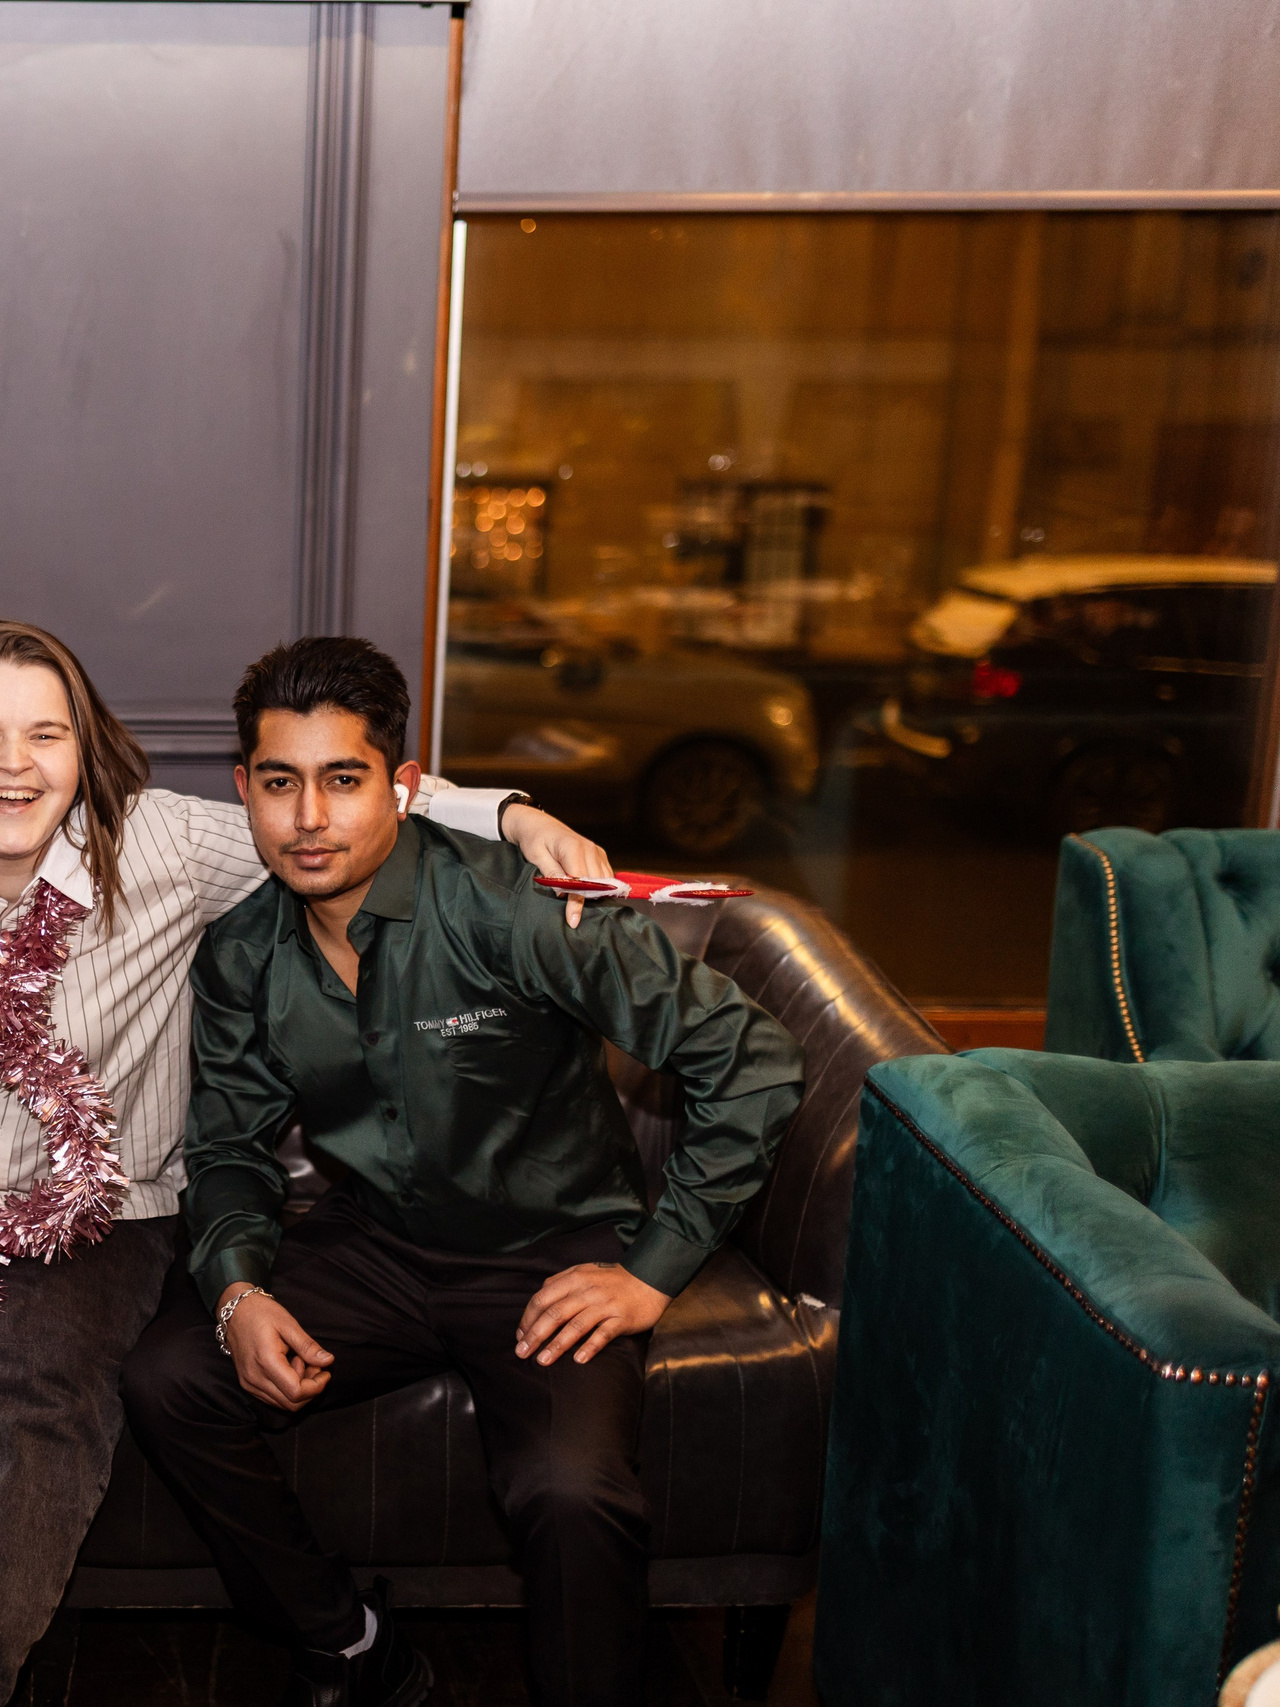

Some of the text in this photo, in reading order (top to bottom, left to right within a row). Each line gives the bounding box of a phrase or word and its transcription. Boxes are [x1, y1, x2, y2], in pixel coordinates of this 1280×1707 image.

[414, 1008, 507, 1031] TOMMY HILFIGER
[440, 1026, 457, 1037] EST
